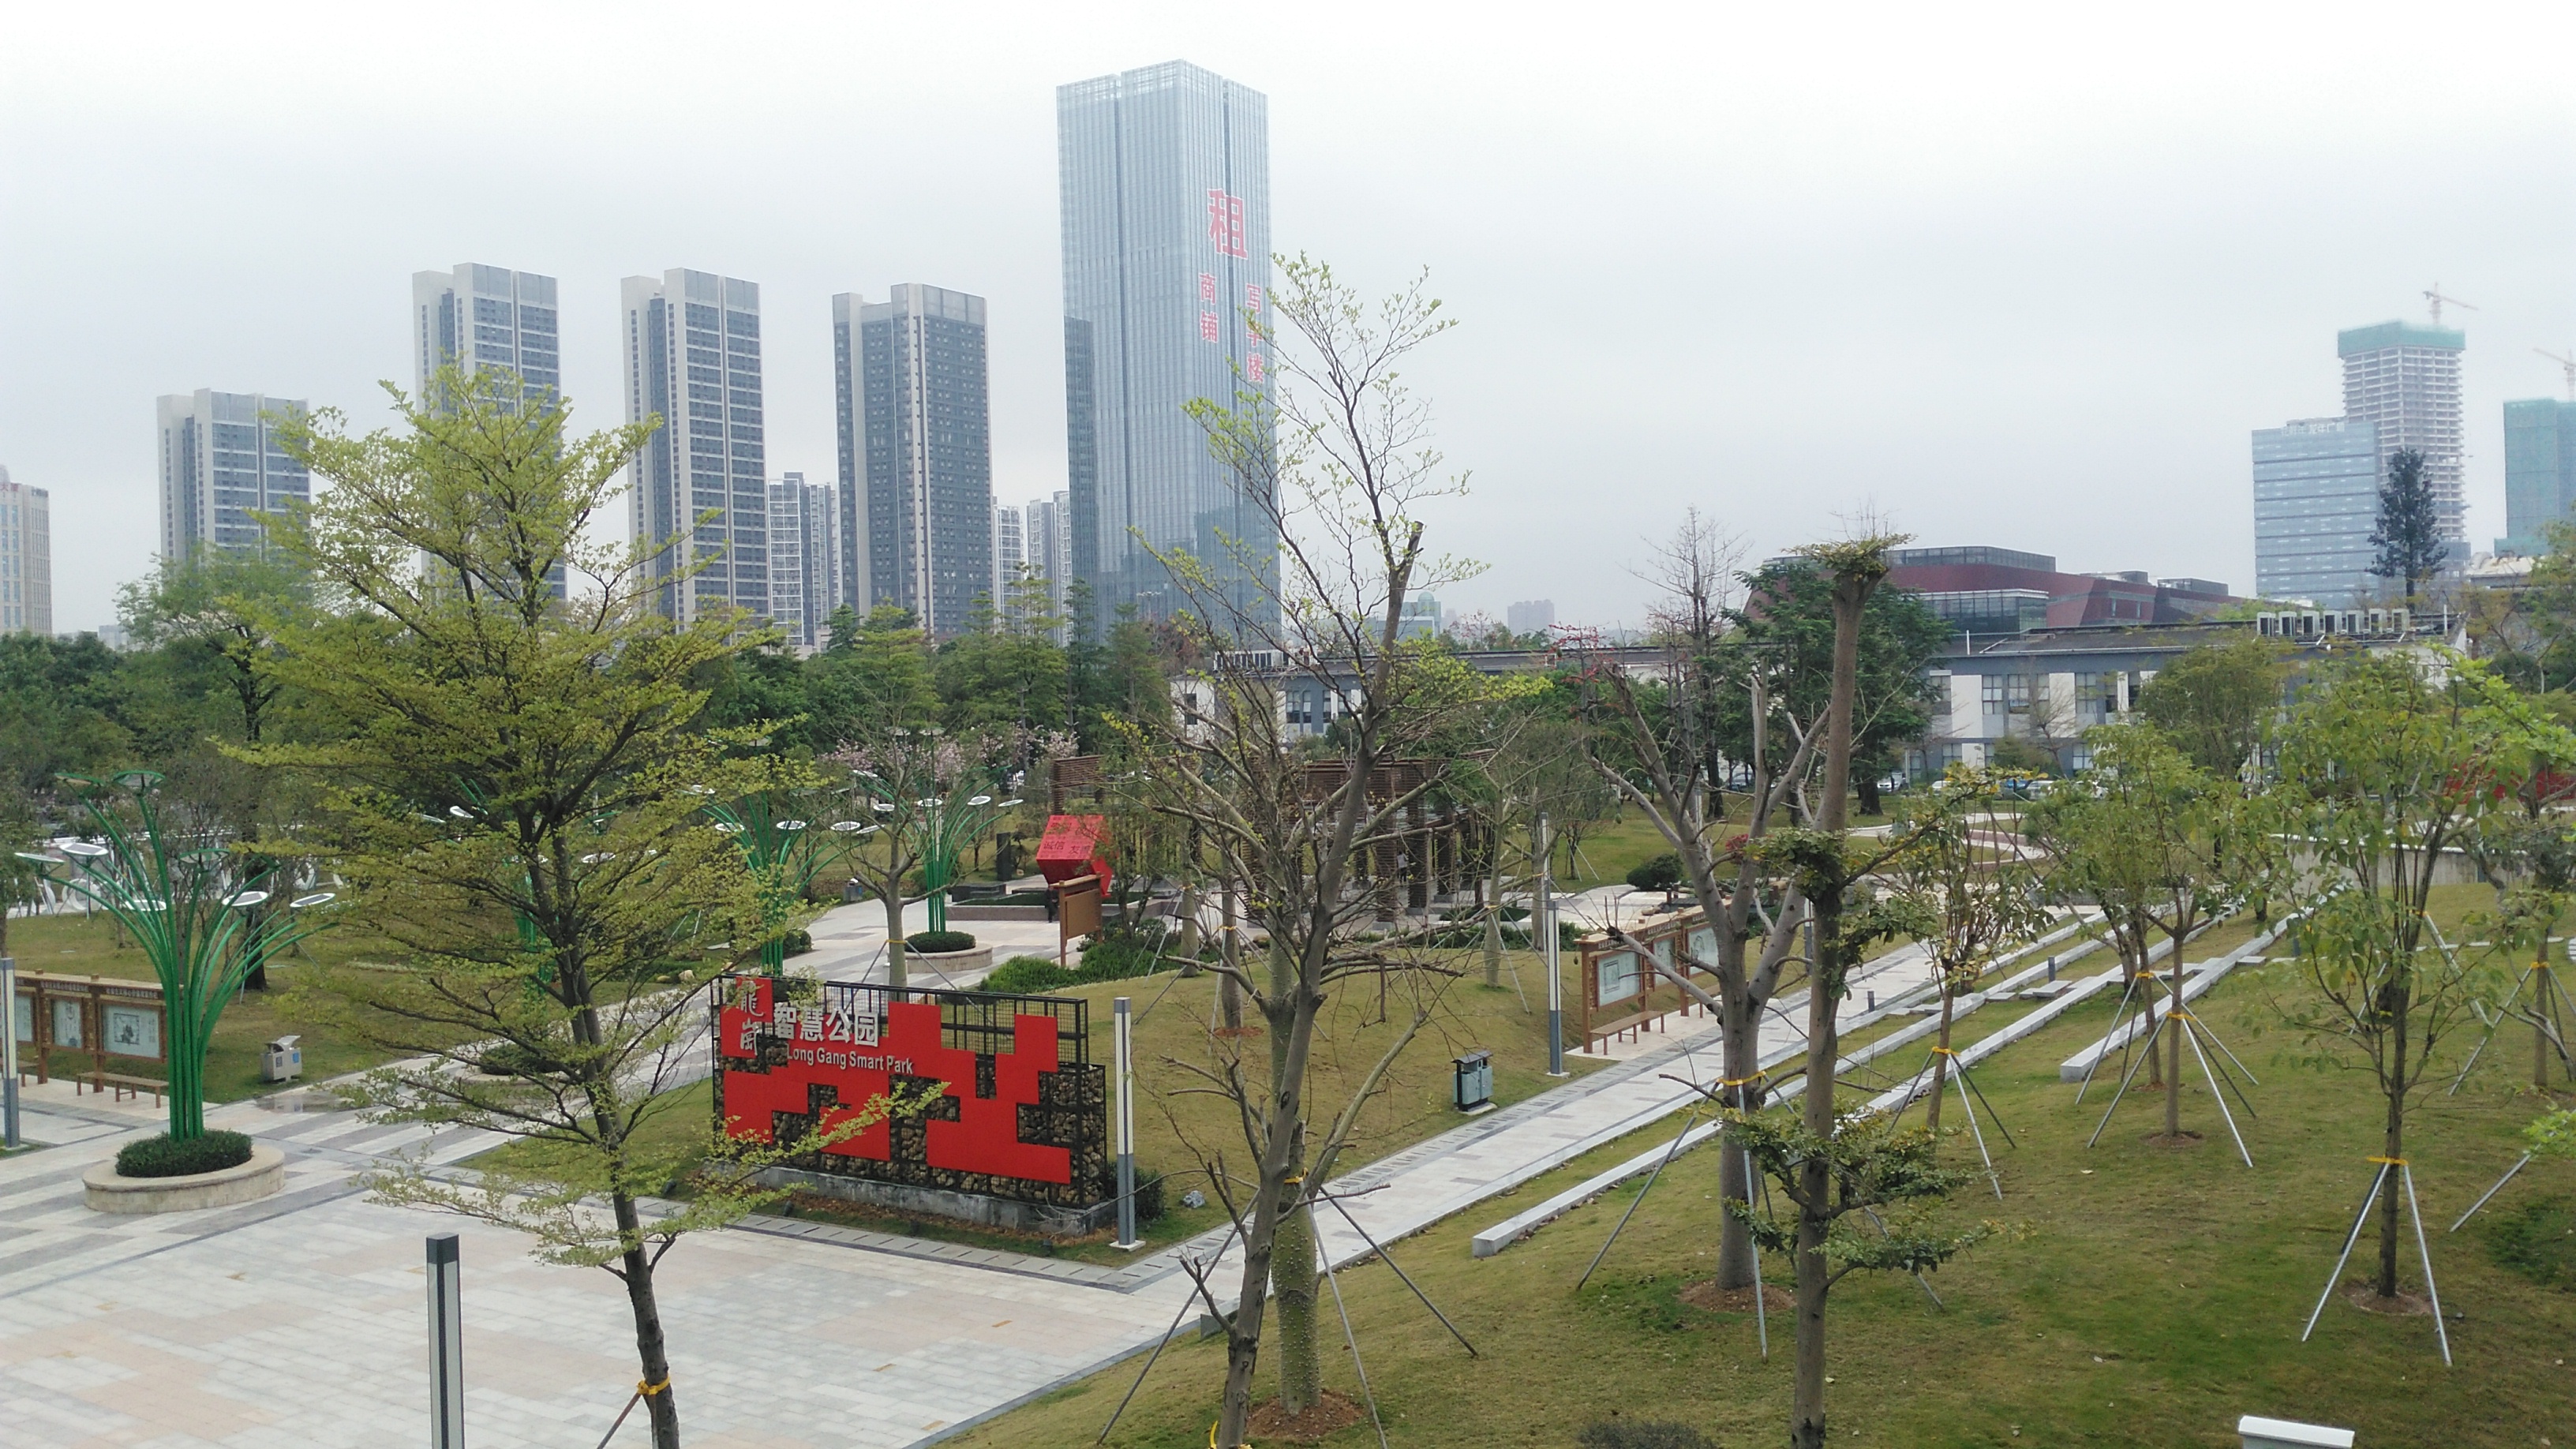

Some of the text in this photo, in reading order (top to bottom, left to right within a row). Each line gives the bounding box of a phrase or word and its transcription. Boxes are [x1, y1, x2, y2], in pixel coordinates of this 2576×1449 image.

[1208, 188, 1248, 260] 租
[1199, 272, 1219, 343] 商铺
[773, 1002, 879, 1047] 智慧公园
[787, 1043, 914, 1075] Long Gang Smart Park
